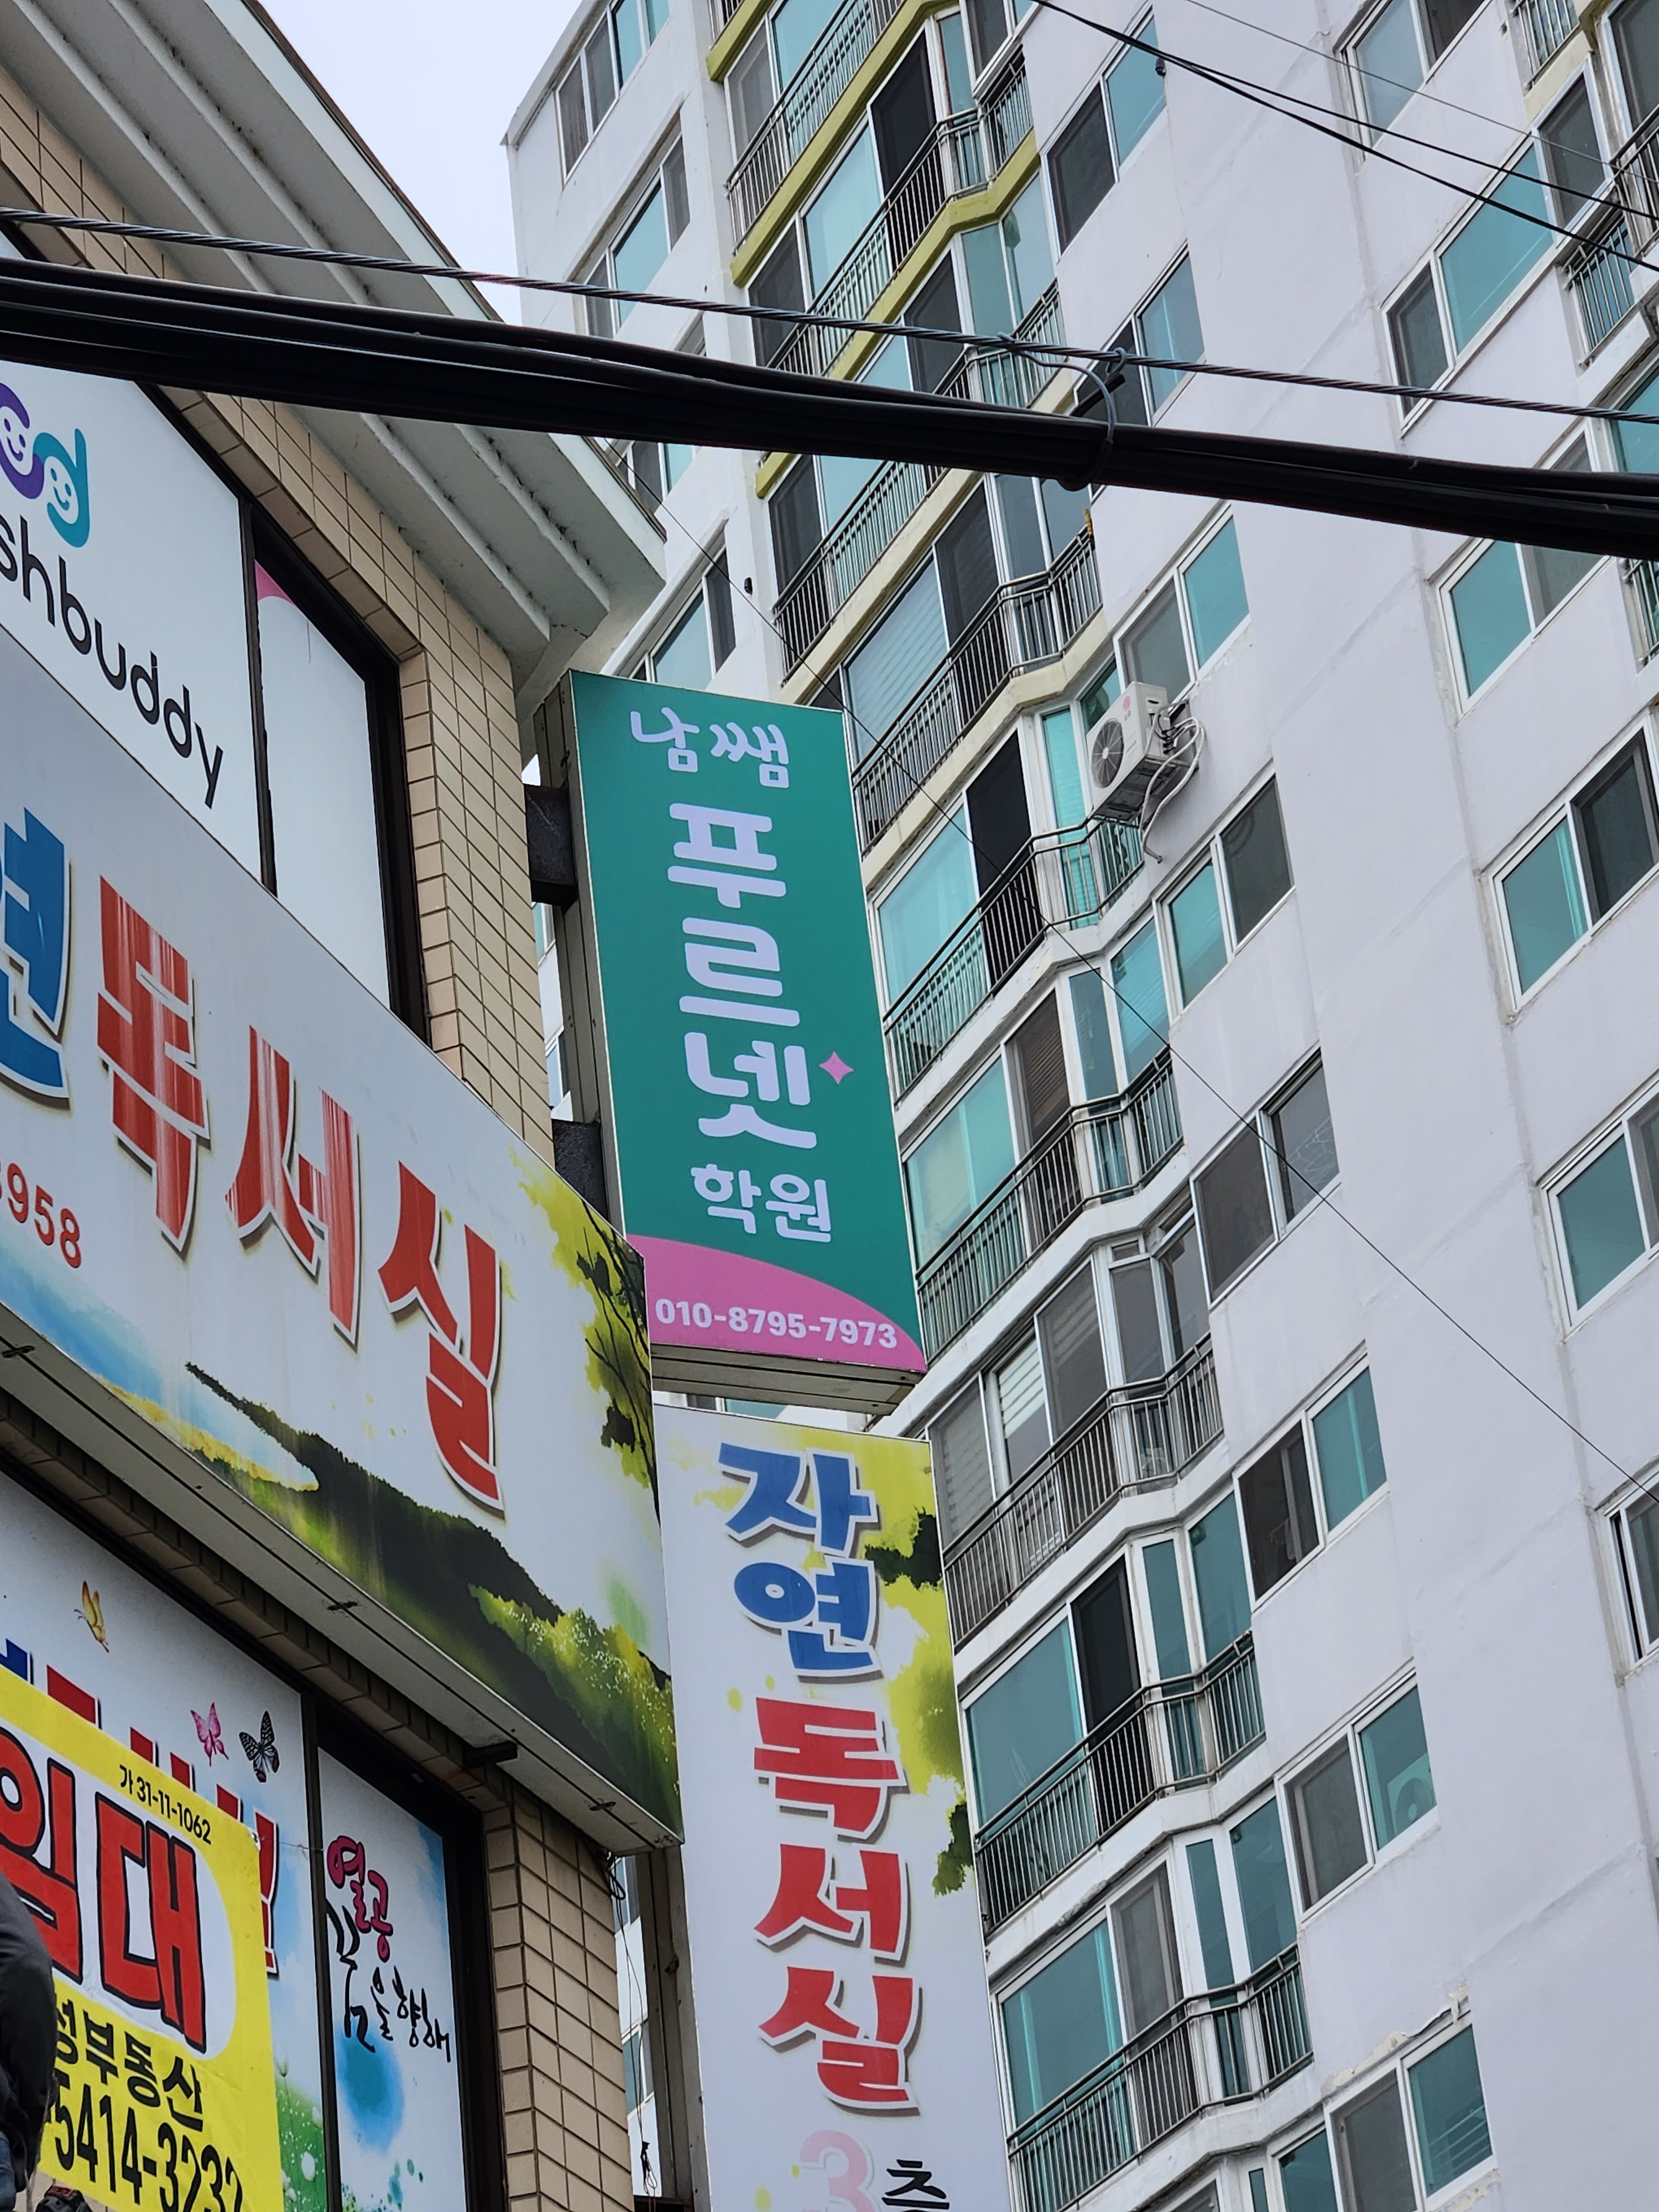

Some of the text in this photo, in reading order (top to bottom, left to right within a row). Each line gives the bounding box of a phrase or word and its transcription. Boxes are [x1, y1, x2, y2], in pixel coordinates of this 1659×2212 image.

[630, 707, 789, 789] 남쌤
[667, 803, 817, 1149] 푸르넷
[0, 1160, 82, 1269] 958
[691, 1163, 831, 1243] 학원
[655, 1298, 898, 1349] 010-8795-7973
[0, 1726, 206, 2054] 임대
[327, 1835, 394, 1963] 열공
